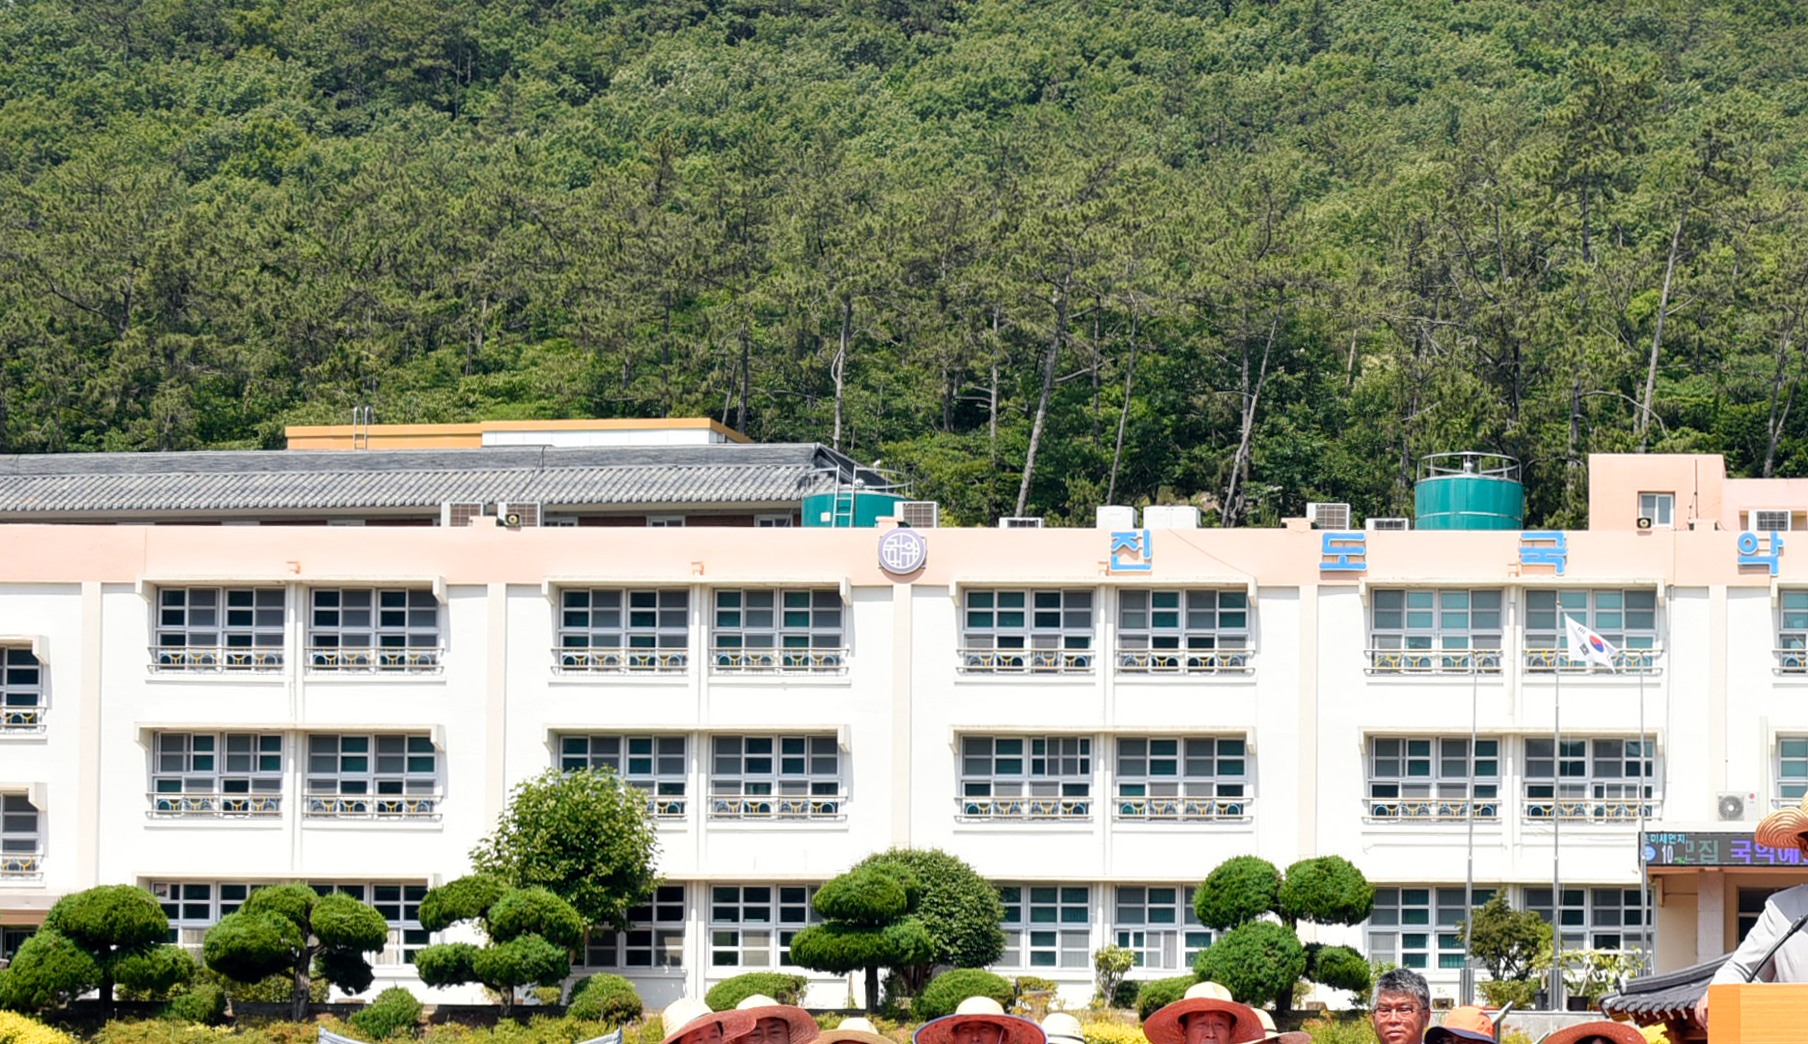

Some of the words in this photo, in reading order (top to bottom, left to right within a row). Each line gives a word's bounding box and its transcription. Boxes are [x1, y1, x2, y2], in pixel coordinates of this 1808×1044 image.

[1110, 529, 1153, 572] 진
[1320, 532, 1368, 571] 도
[1520, 532, 1568, 576] 국
[1737, 530, 1781, 577] 악
